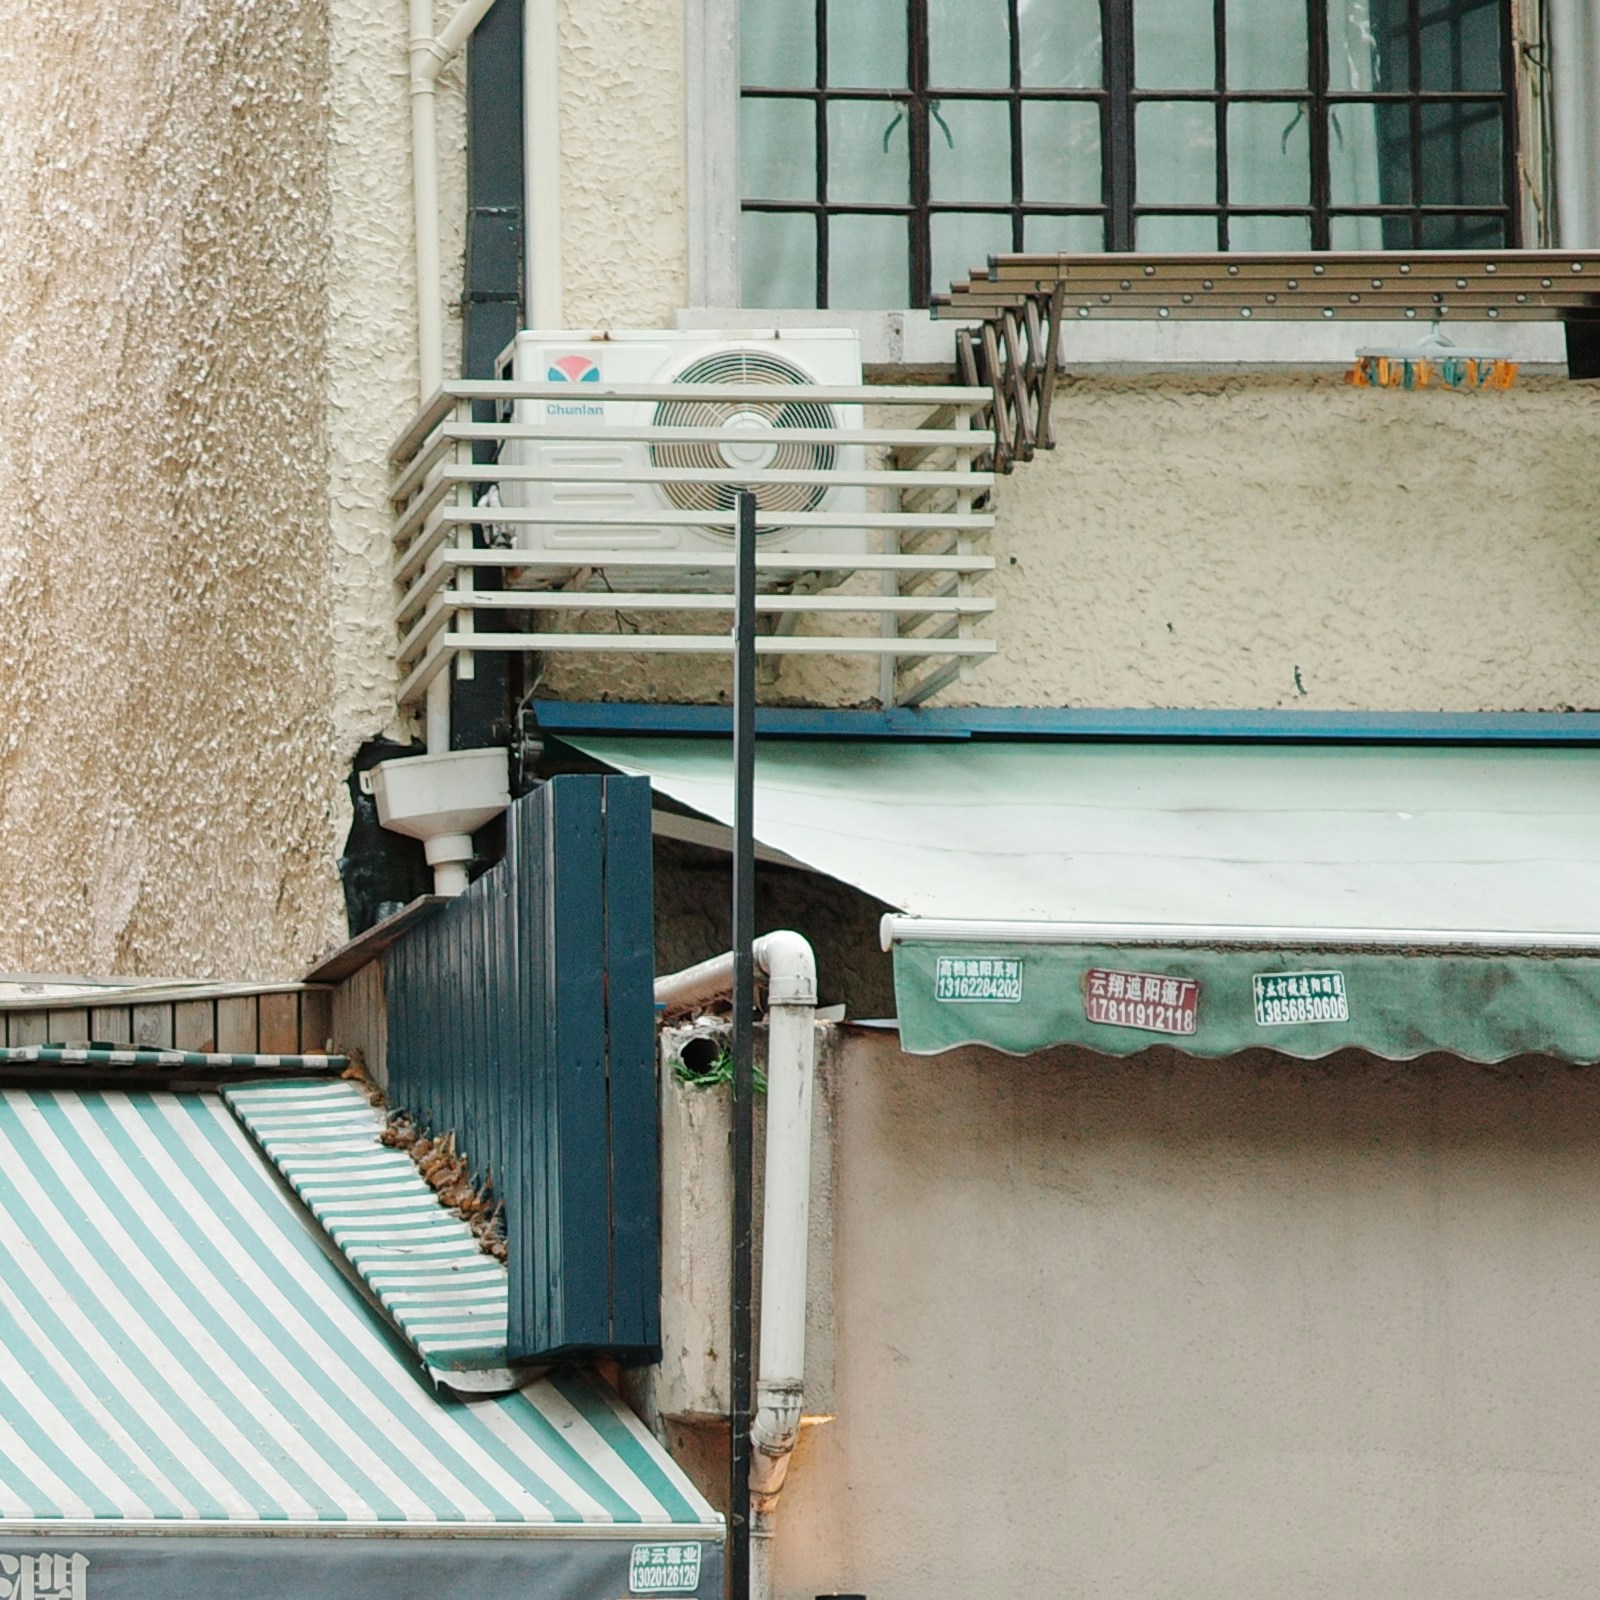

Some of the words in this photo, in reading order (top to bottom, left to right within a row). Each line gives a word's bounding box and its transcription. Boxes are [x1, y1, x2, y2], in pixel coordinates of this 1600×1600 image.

[546, 403, 604, 416] Chunlan
[939, 977, 1019, 998] 13162284202
[1090, 997, 1193, 1031] 17811912118
[1258, 996, 1346, 1023] 13856850606
[632, 1565, 696, 1588] 13020126126
